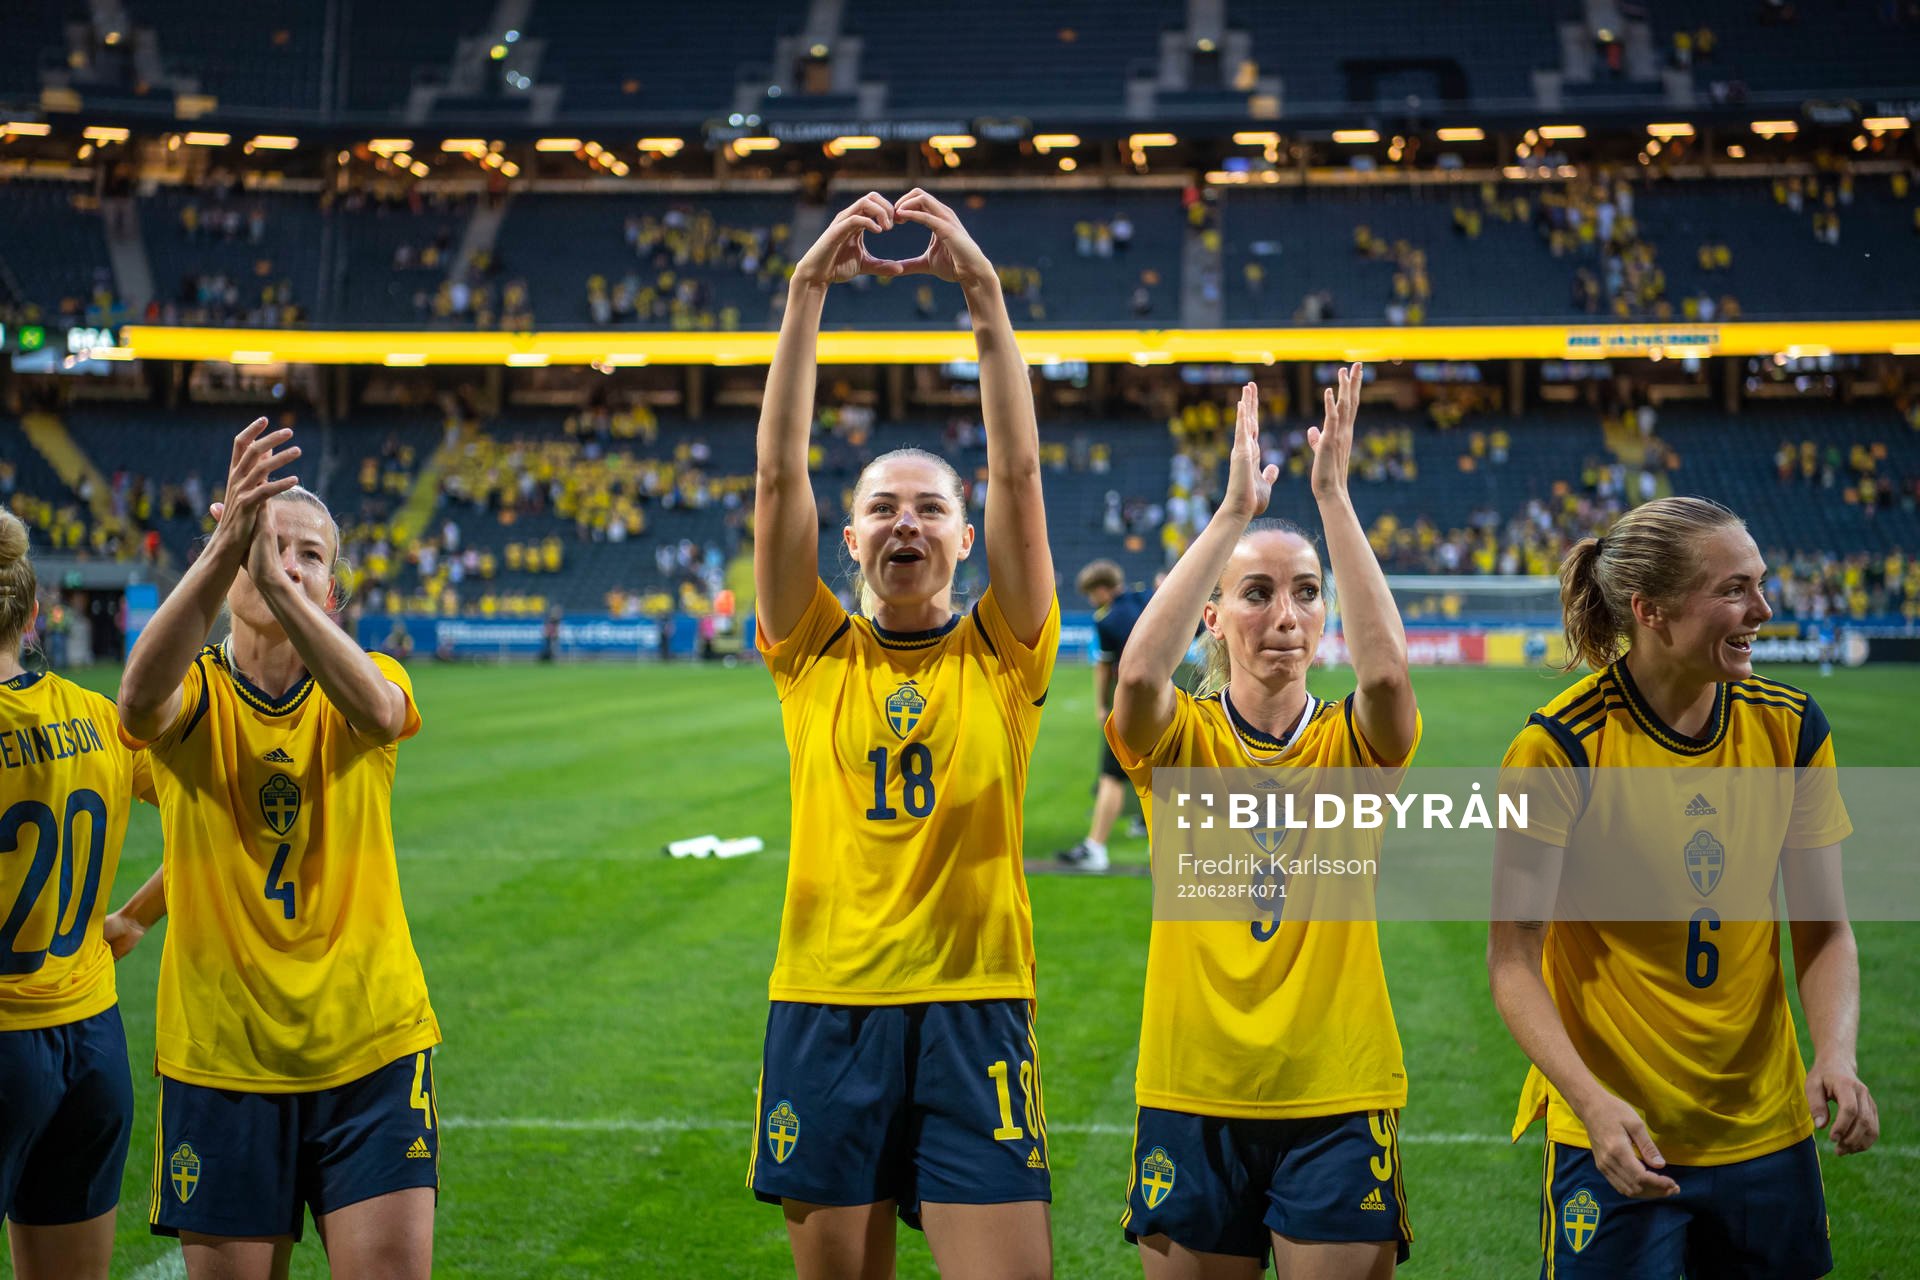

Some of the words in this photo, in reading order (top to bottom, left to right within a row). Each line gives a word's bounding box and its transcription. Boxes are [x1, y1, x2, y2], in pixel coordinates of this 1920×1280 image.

[0, 718, 104, 769] ENNISON
[866, 742, 936, 820] 18
[1684, 806, 1717, 817] adidas
[0, 788, 107, 975] 20
[264, 843, 296, 920] 4
[1249, 864, 1286, 943] 9
[1685, 907, 1721, 989] 6
[410, 1052, 432, 1130] 4
[987, 1060, 1039, 1140] 18
[406, 1150, 431, 1159] adidas
[1368, 1109, 1392, 1182] 9
[1360, 1200, 1386, 1211] adidas
